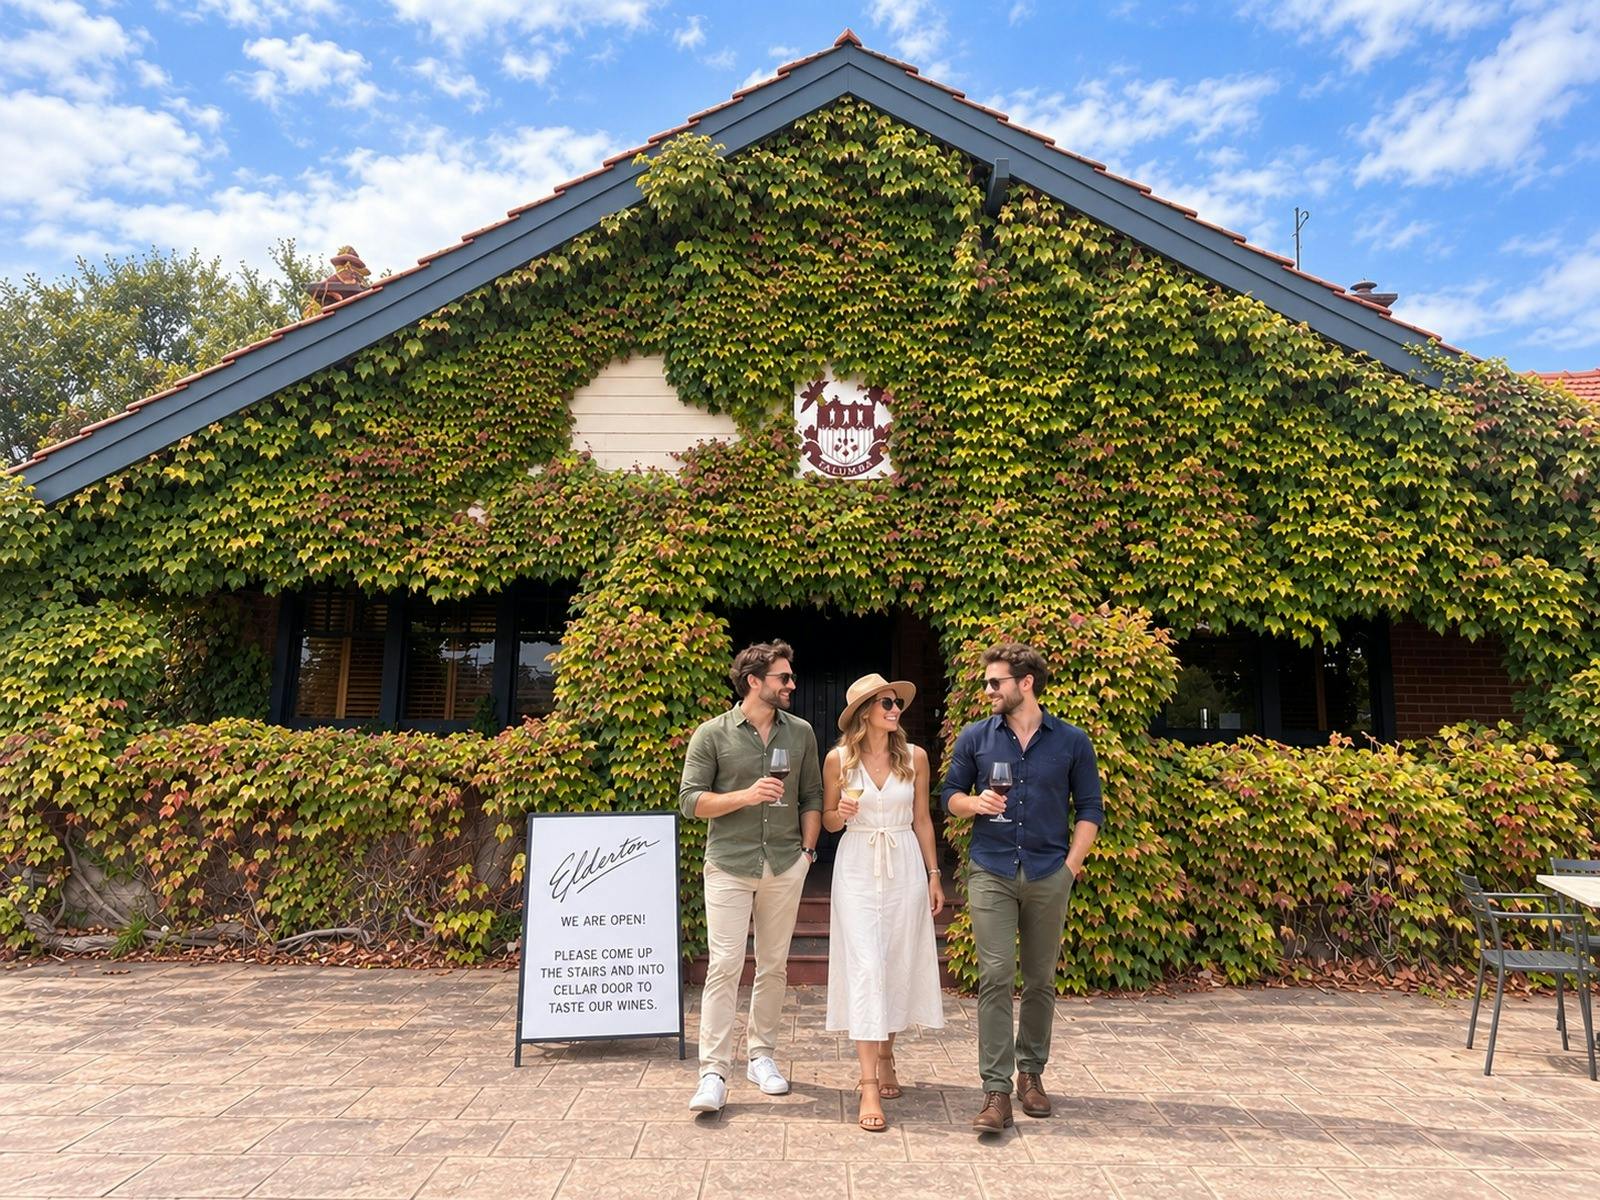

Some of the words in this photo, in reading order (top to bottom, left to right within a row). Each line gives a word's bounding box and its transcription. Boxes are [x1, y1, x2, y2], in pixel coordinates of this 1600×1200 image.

[549, 836, 660, 903] Elderton
[560, 915, 579, 927] WE
[583, 915, 606, 926] ARE
[610, 914, 646, 926] OPEN!
[554, 949, 598, 961] PLEASE
[601, 948, 634, 960] COME
[637, 947, 653, 959] UP
[540, 967, 563, 979] THE
[567, 965, 607, 978] STAIRS
[610, 965, 634, 977] AND
[638, 963, 665, 975] INTO
[553, 983, 598, 996] CELLAR
[601, 981, 633, 994] DOOR
[636, 981, 652, 993] TO
[548, 1002, 585, 1014] TASTE
[588, 1000, 613, 1013] OUR
[616, 999, 658, 1011] WINES.
